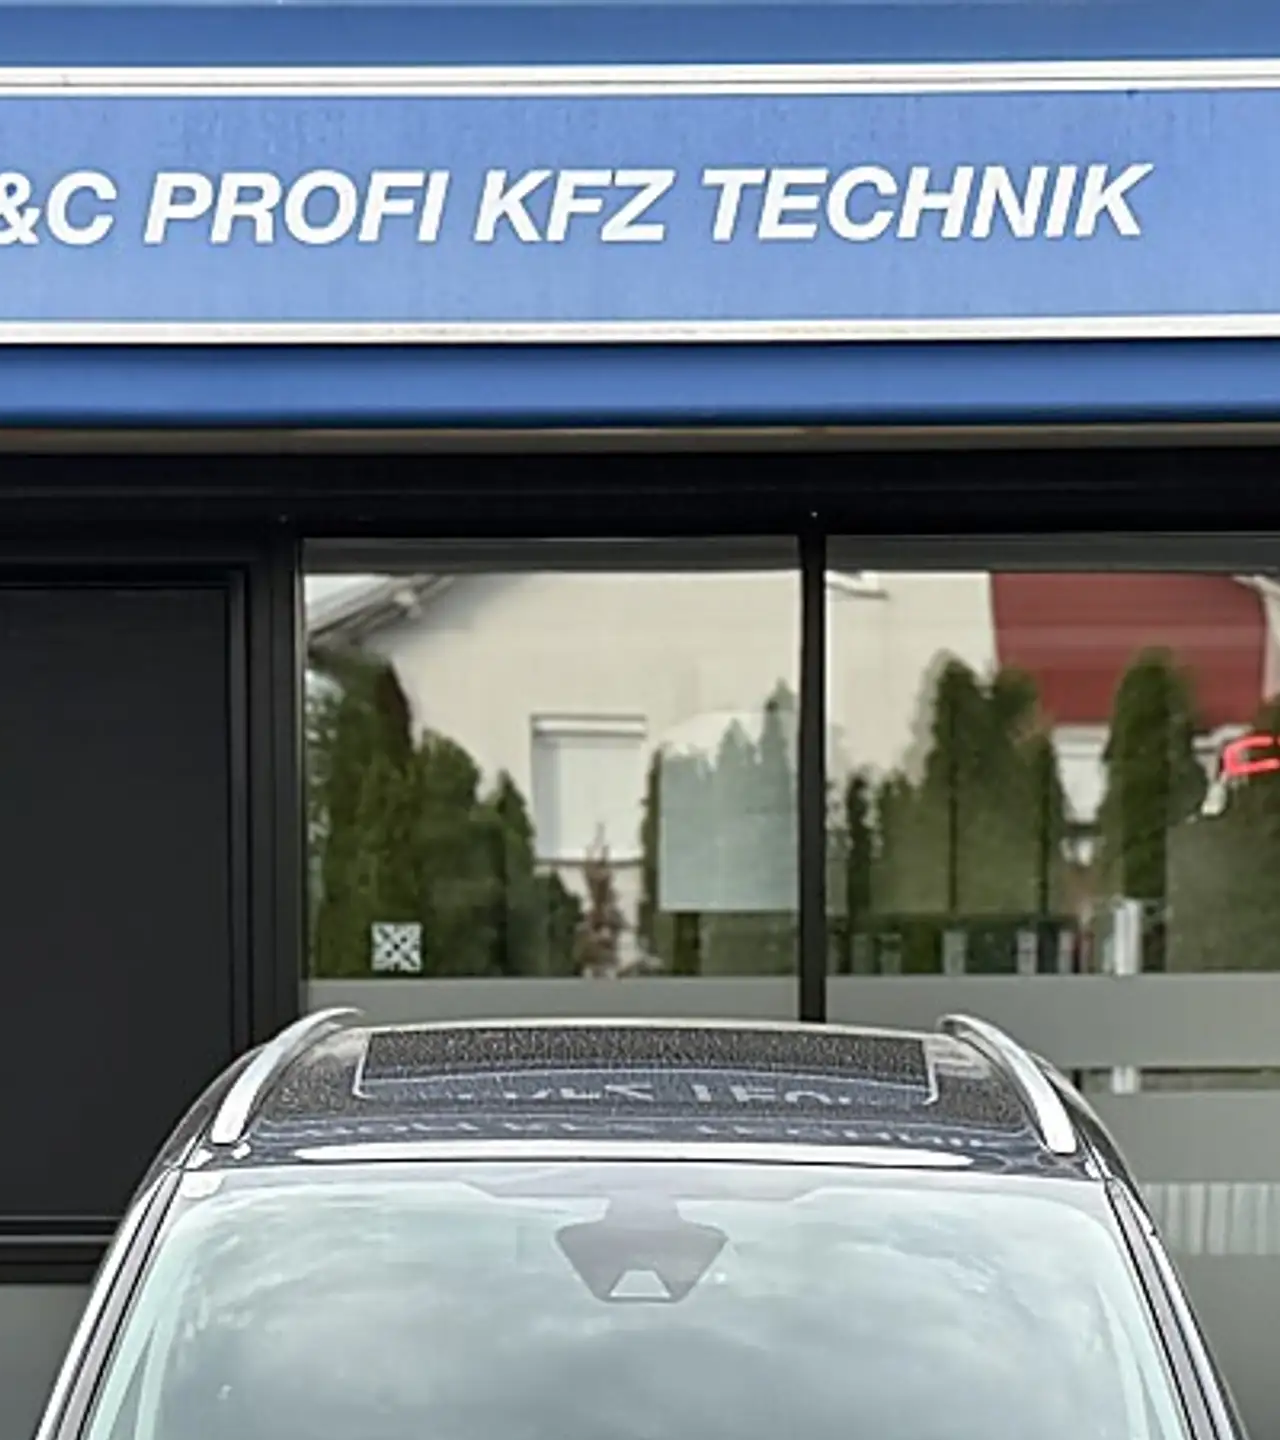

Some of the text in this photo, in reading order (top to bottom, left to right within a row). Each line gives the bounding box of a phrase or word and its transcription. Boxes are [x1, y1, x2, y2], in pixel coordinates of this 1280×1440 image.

[144, 169, 450, 245] PROFI
[474, 169, 676, 242] KFZ
[702, 163, 1154, 241] TECHNIK
